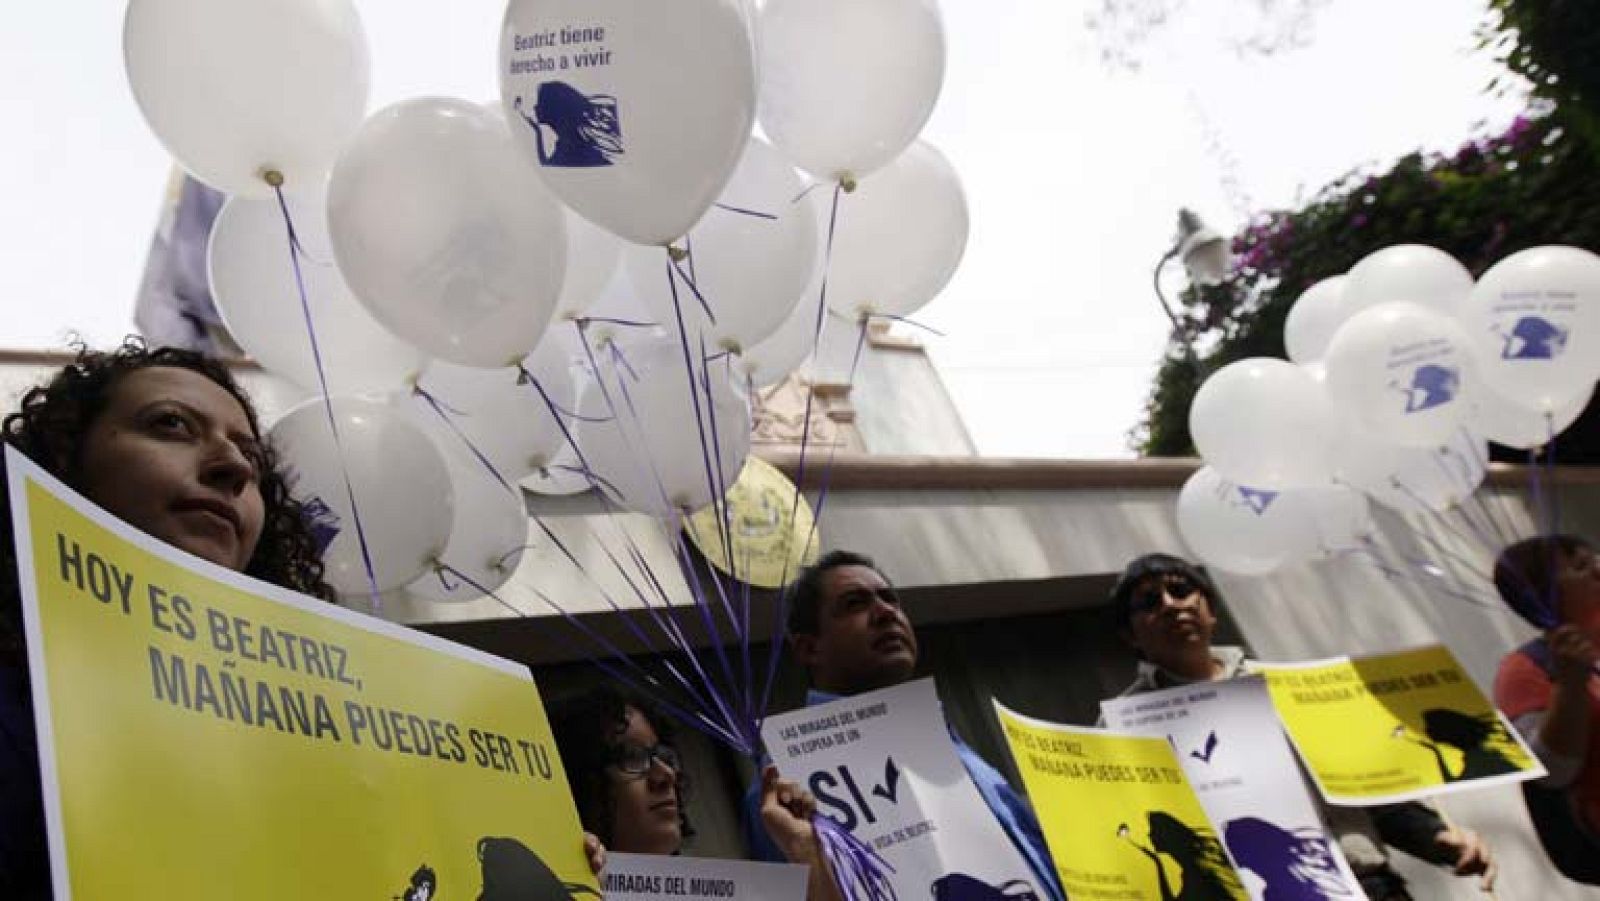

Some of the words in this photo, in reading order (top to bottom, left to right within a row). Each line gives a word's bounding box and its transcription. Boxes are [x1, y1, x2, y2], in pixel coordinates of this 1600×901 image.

[514, 29, 555, 51] Beatriz
[560, 25, 605, 44] tiene
[560, 55, 569, 70] a
[574, 46, 611, 67] vivir
[57, 532, 134, 615] HOY
[148, 583, 196, 641] ES
[206, 607, 363, 691] BEATRIZ,
[147, 645, 341, 742] MAÑANA
[344, 700, 467, 763] PUEDES
[468, 729, 520, 774] SER
[517, 740, 553, 780] TU
[808, 764, 877, 833] SI
[664, 877, 686, 896] DEL
[690, 878, 735, 898] MUNDO
